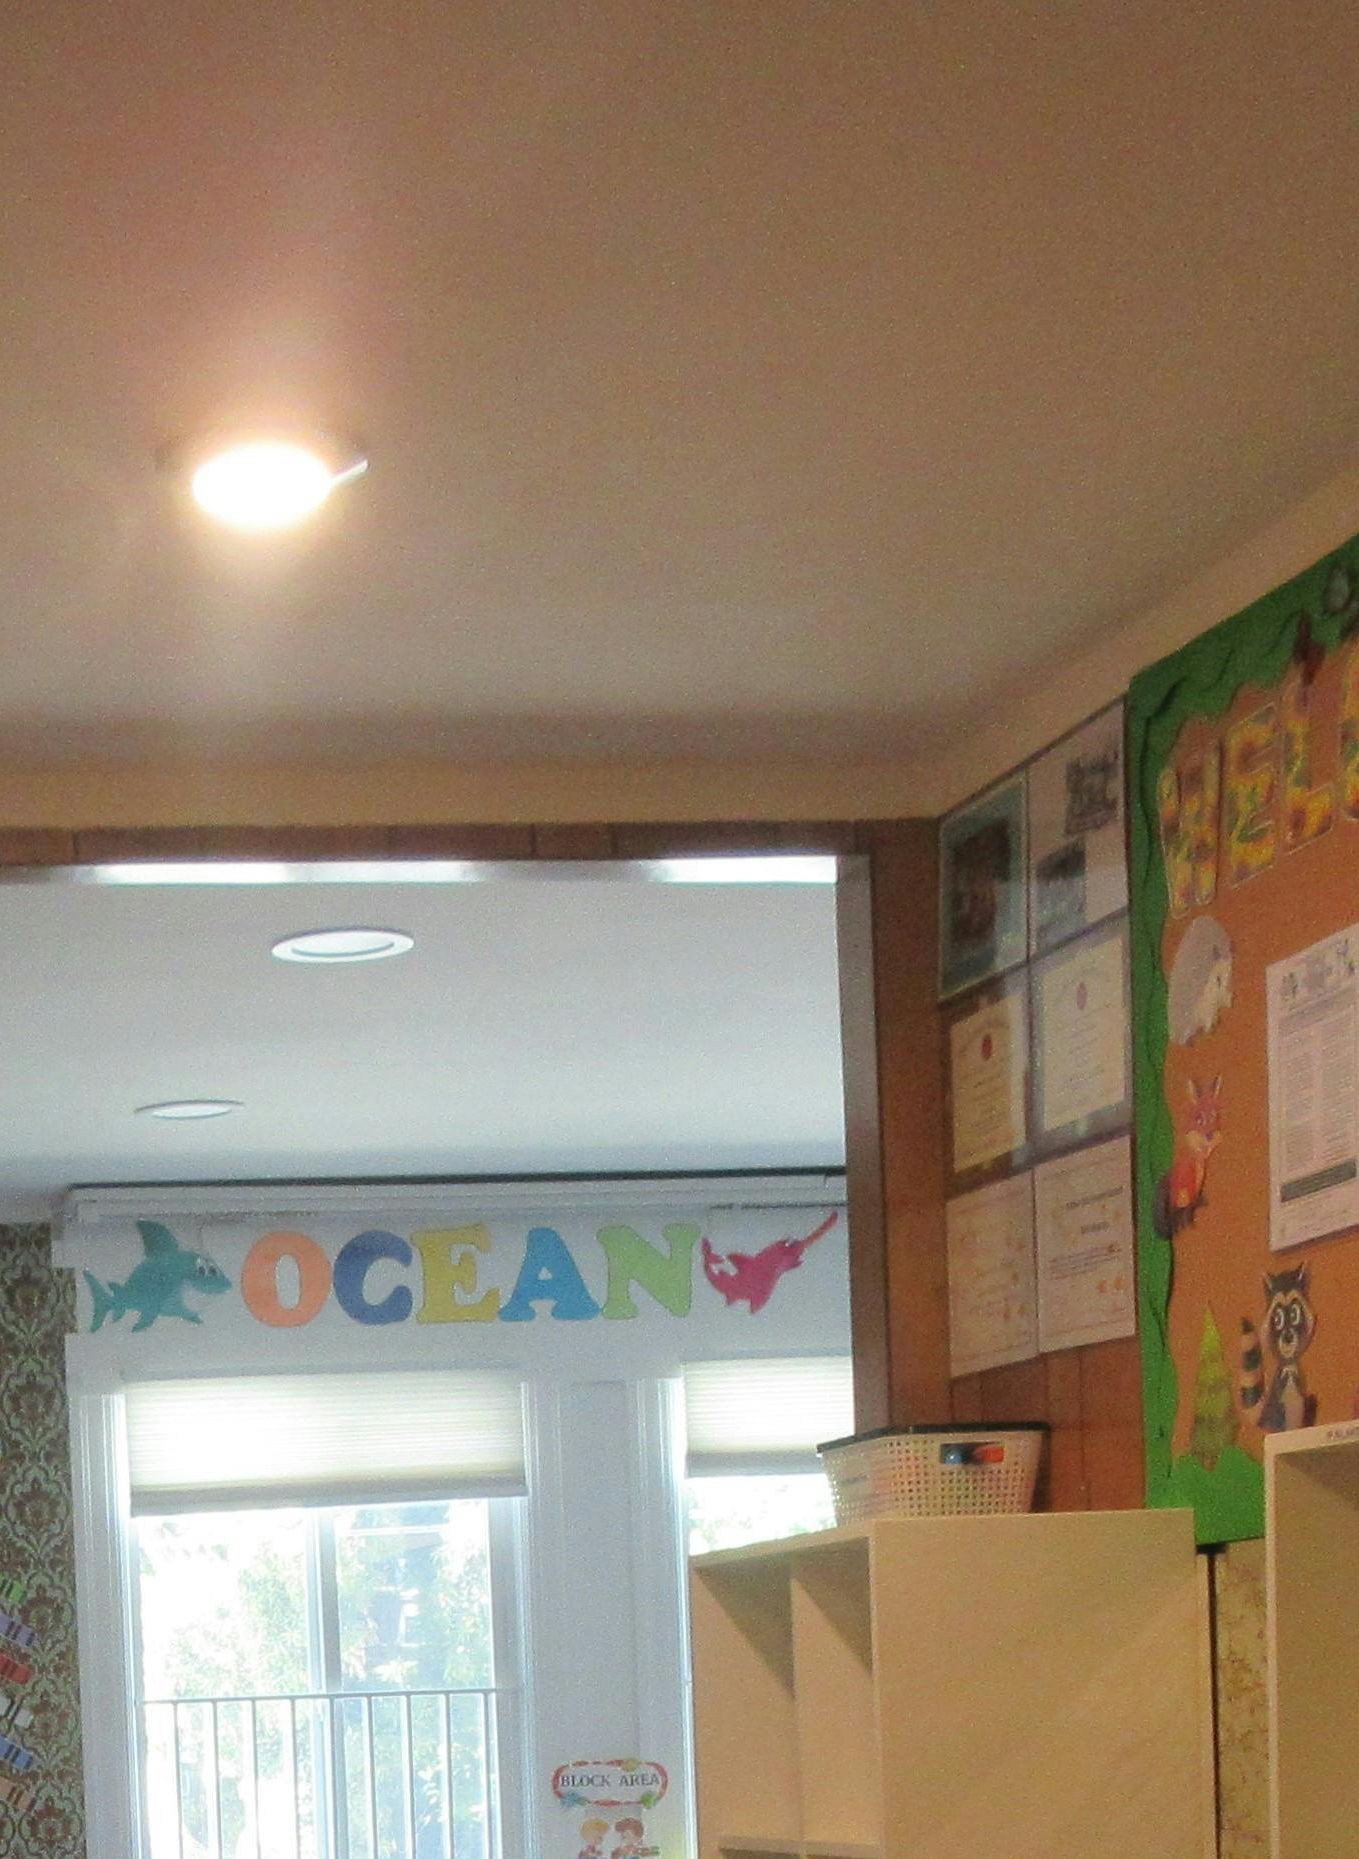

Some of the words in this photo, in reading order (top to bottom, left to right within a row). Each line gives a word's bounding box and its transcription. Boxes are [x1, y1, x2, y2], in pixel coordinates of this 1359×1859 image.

[241, 1222, 701, 1327] OCEAN
[561, 1774, 611, 1788] BLOCK
[619, 1773, 660, 1787] AREA
